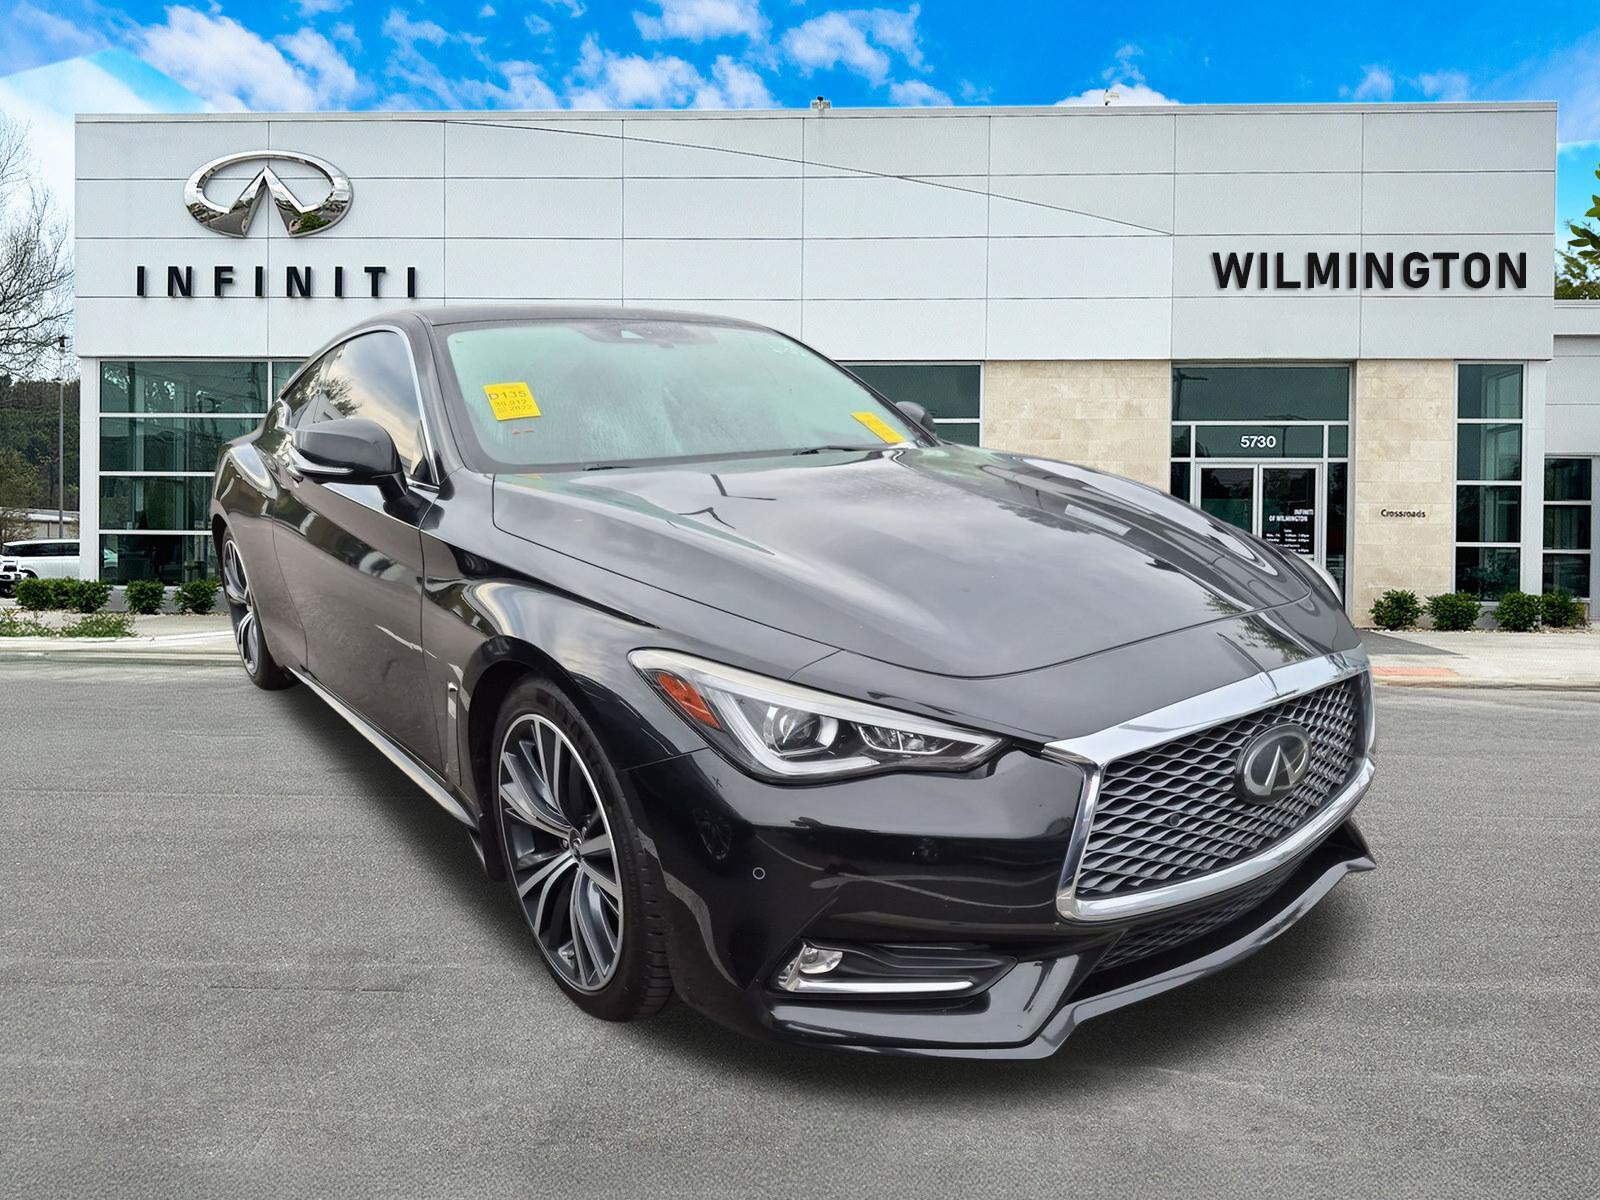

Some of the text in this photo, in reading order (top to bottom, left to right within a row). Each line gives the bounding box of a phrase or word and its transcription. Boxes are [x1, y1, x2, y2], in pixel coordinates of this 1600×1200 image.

[1213, 252, 1527, 289] WILMINGTON
[137, 266, 416, 297] INFINITI
[488, 391, 527, 400] D135
[1240, 435, 1277, 448] 5730
[1380, 508, 1426, 518] Crossroads
